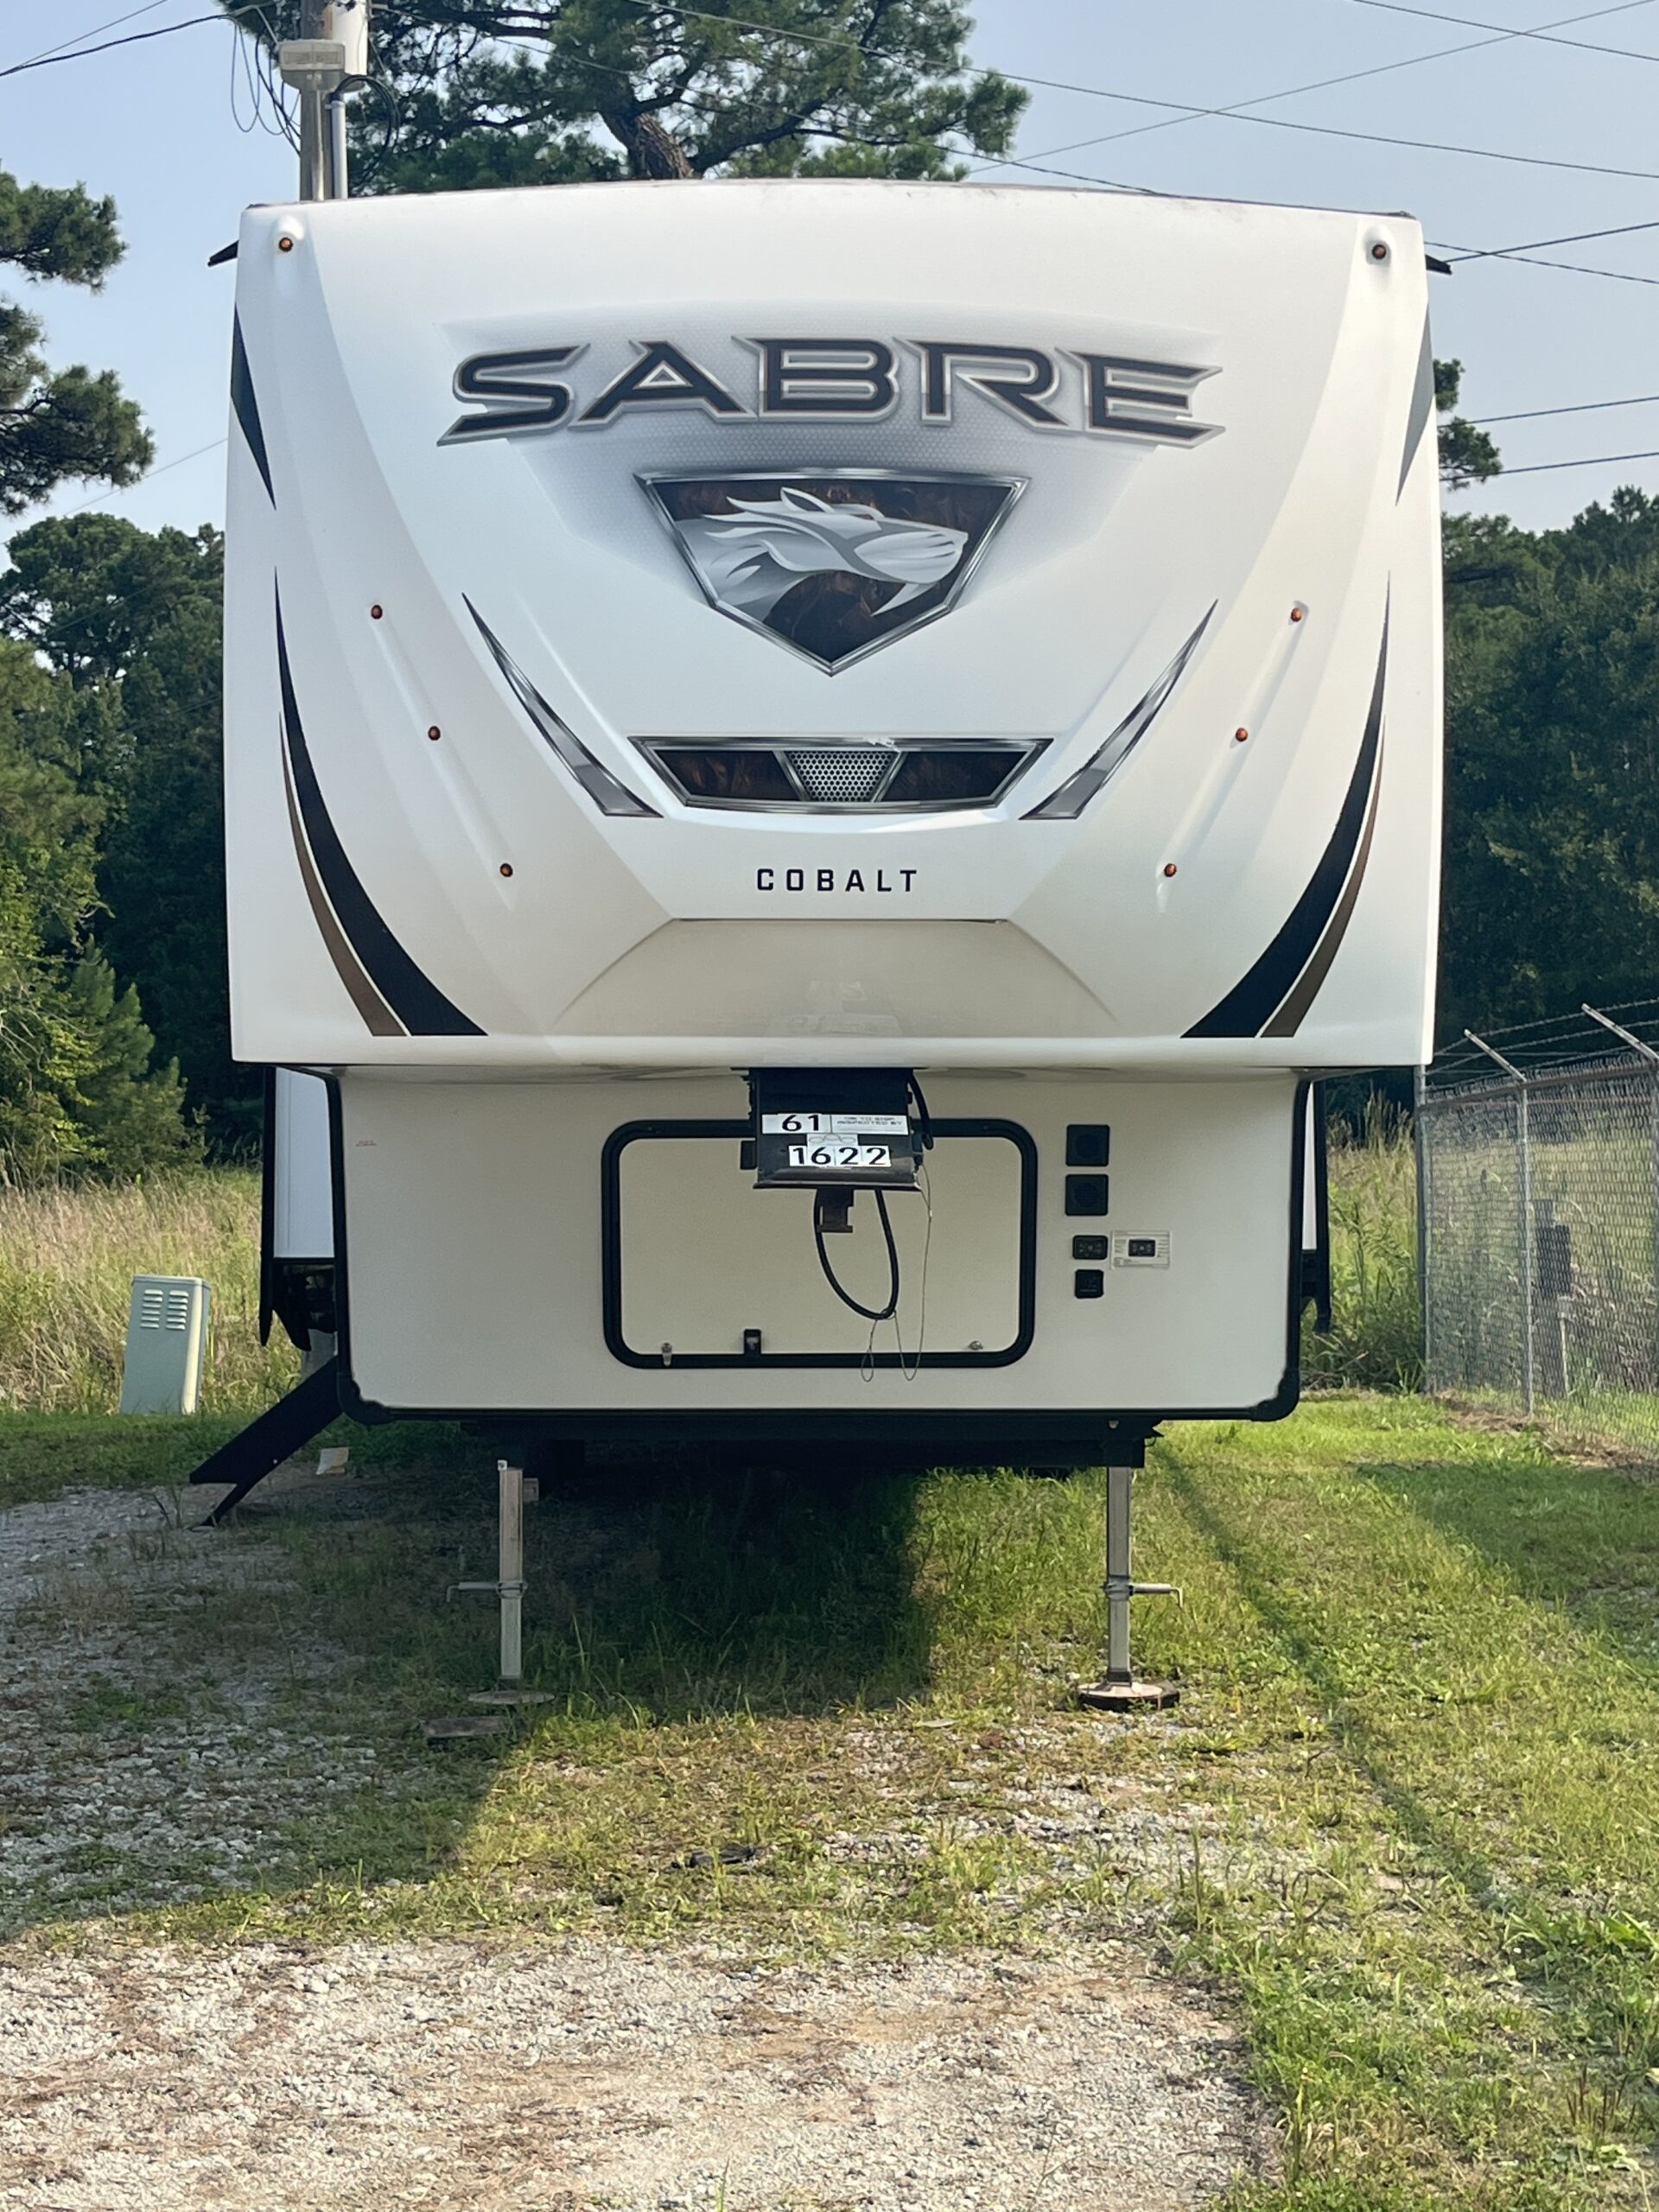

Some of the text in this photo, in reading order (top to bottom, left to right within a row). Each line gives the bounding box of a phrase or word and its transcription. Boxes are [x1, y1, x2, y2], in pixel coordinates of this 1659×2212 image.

[436, 337, 1225, 448] SABRE
[757, 868, 917, 892] COBALT
[781, 1114, 819, 1132] 61
[792, 1147, 887, 1166] 1622
